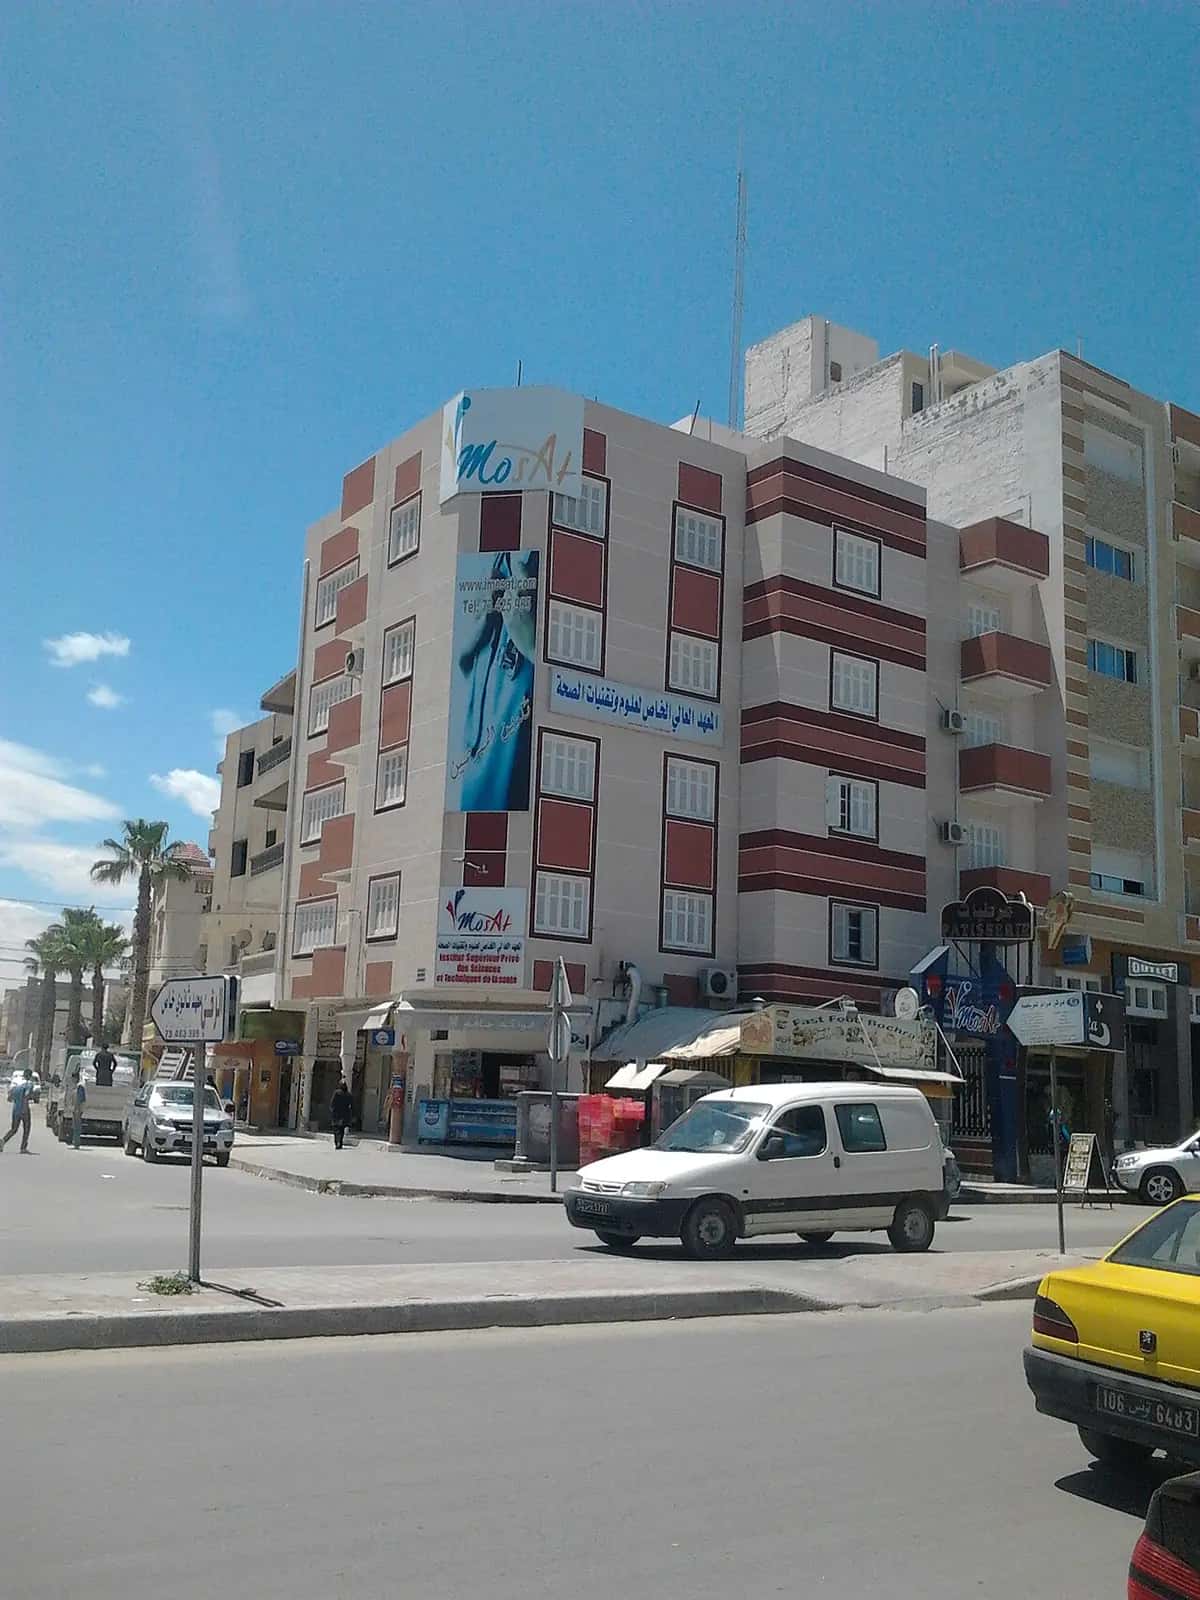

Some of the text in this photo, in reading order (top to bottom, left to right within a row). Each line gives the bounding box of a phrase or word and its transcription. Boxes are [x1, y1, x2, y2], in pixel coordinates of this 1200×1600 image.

[458, 577, 537, 592] www.imosat.com
[943, 922, 1031, 937] PATISSERIE
[1131, 961, 1174, 978] OUTLET
[792, 1016, 825, 1027] Fast
[1103, 1389, 1125, 1412] 106
